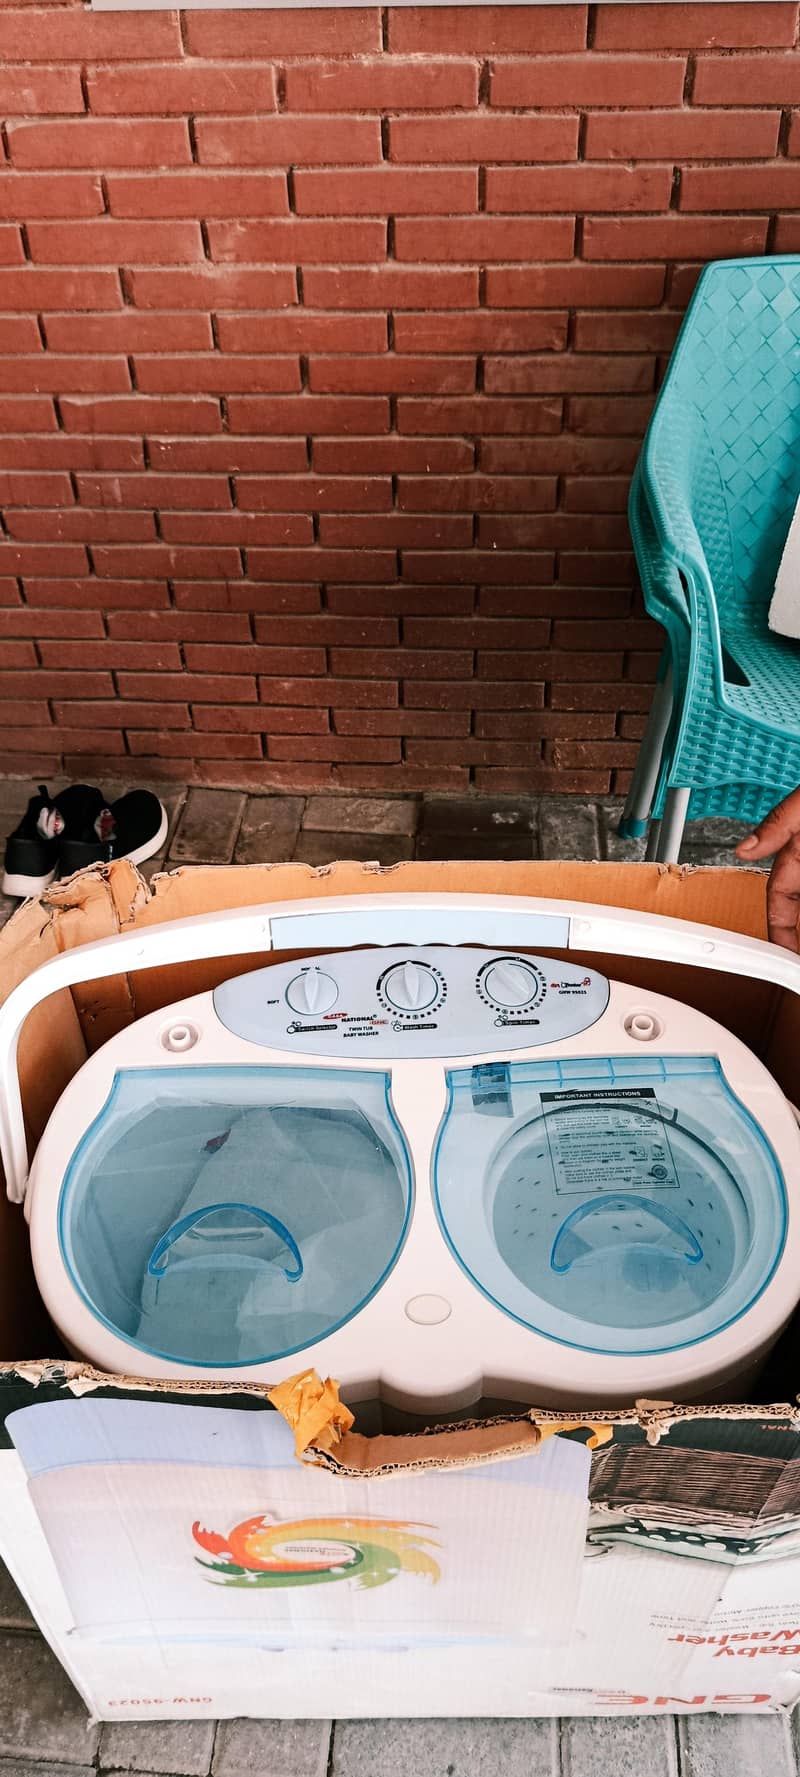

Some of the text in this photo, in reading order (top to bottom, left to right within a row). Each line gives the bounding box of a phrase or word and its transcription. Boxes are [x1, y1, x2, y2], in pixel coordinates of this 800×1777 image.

[341, 1015, 374, 1023] NATIONAL
[554, 1090, 641, 1100] IMPORTANT INSTRUCTIONS
[667, 1629, 800, 1646] Washer
[712, 1645, 800, 1659] Baby
[594, 1693, 772, 1706] GNC
